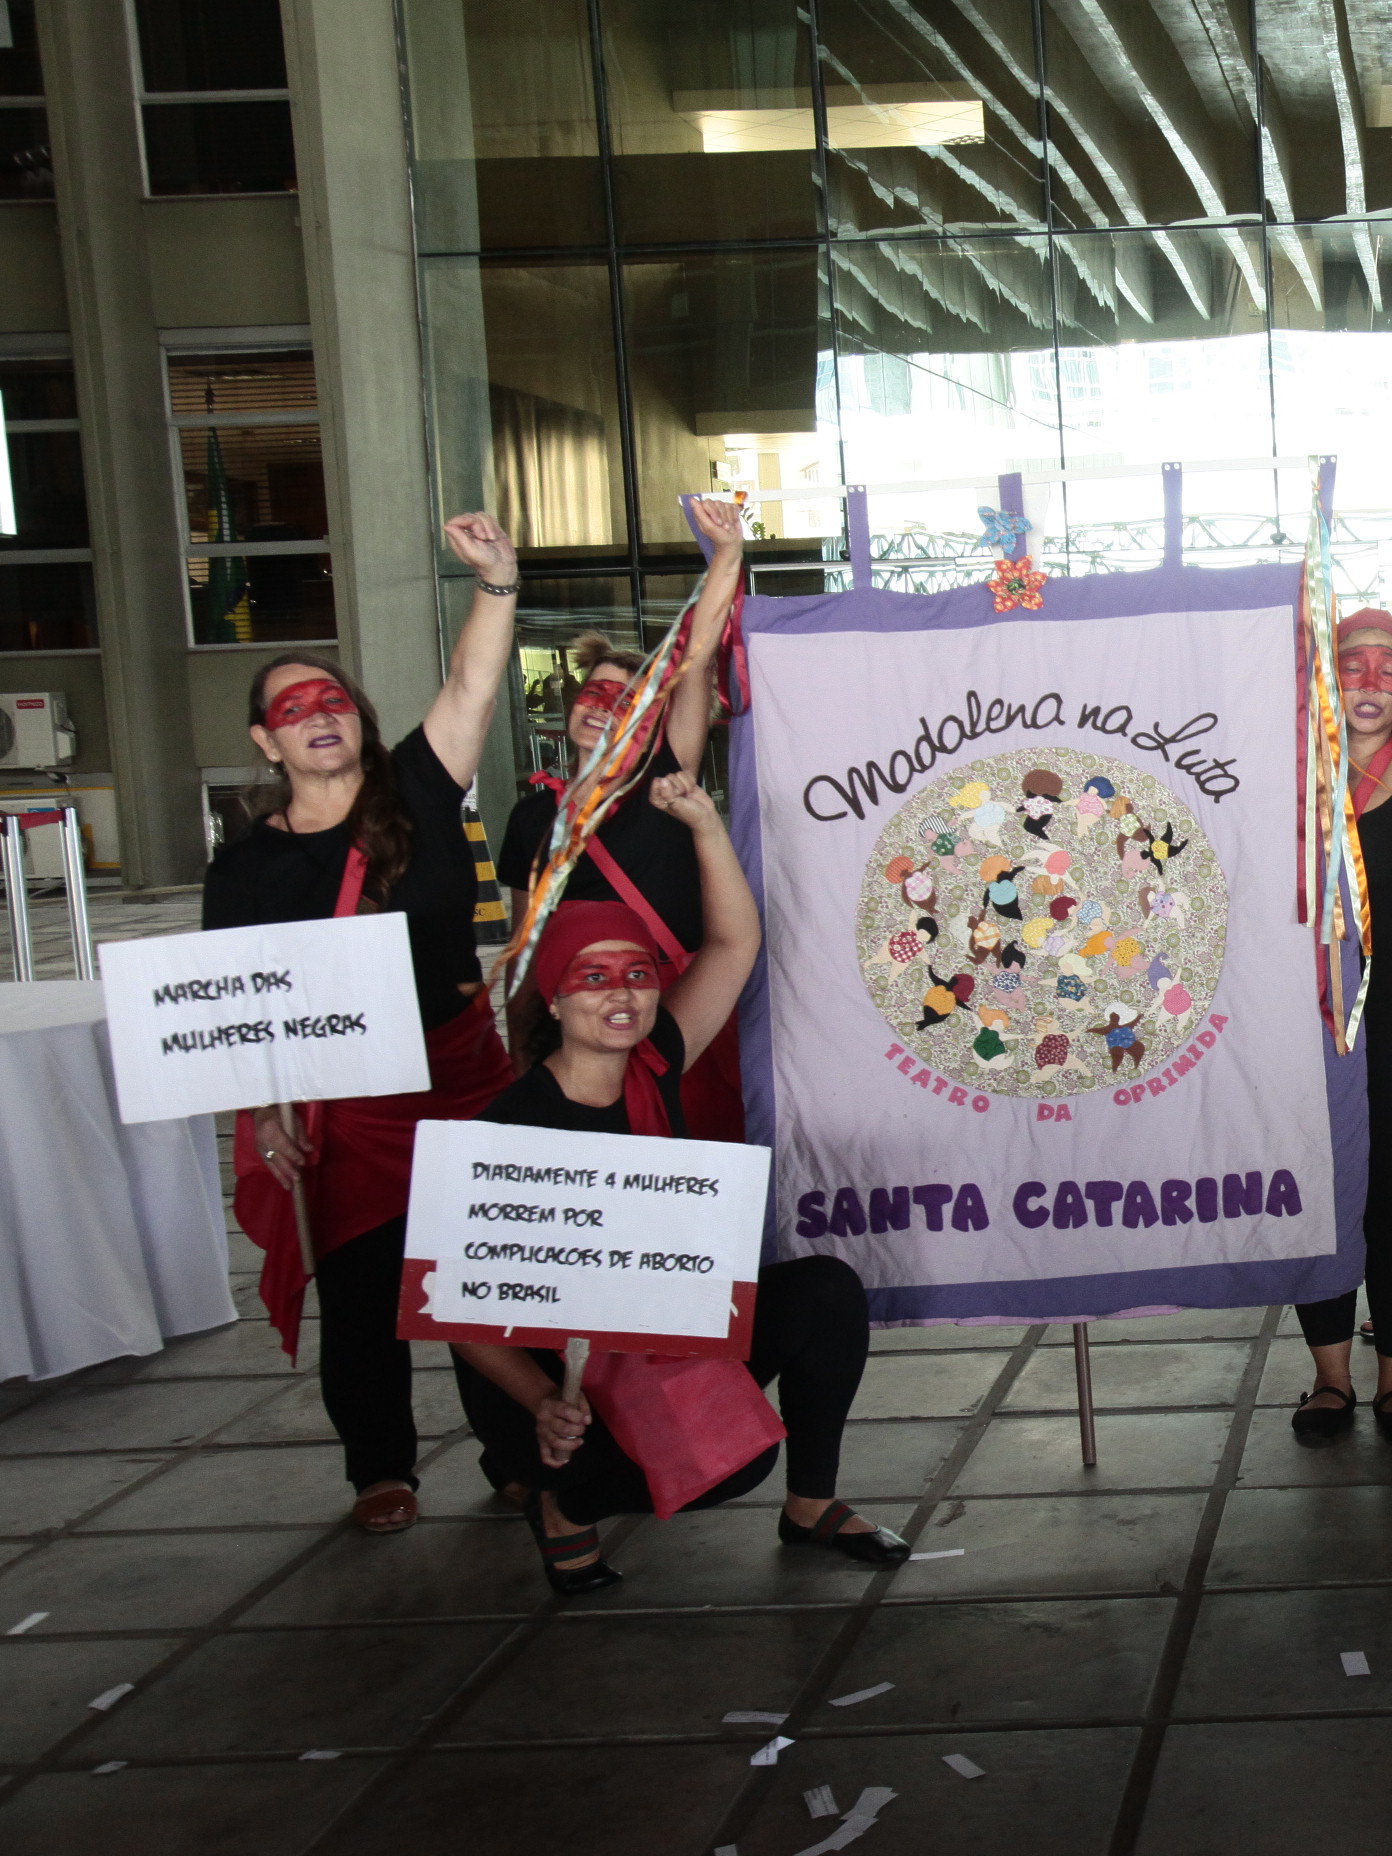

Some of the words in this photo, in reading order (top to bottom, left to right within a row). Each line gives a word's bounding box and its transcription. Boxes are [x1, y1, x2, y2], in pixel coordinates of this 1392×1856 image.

[803, 689, 1063, 823] Madalena
[1079, 701, 1133, 739] na
[1131, 712, 1240, 803] Luta
[153, 975, 246, 1006] MARCHA
[250, 969, 293, 994] DAS
[161, 1020, 276, 1055] MULHERES
[282, 1012, 367, 1040] NEGRAS
[883, 1042, 991, 1114] TEATRO
[1036, 1102, 1072, 1122] DA
[1113, 1011, 1230, 1109] OPRIMIDA
[472, 1161, 599, 1189] DIARIAMENTE
[604, 1172, 616, 1188] 4
[622, 1173, 719, 1197] MULHERES
[468, 1202, 556, 1224] MORREM
[562, 1207, 604, 1228] POR
[796, 1182, 989, 1238] SANTA
[1012, 1169, 1303, 1231] CATARINA
[463, 1241, 603, 1268] COMPLICACOES
[608, 1249, 634, 1270] DE
[638, 1251, 715, 1274] ABORTO
[461, 1281, 492, 1300] NO
[496, 1281, 561, 1304] BRASIL
